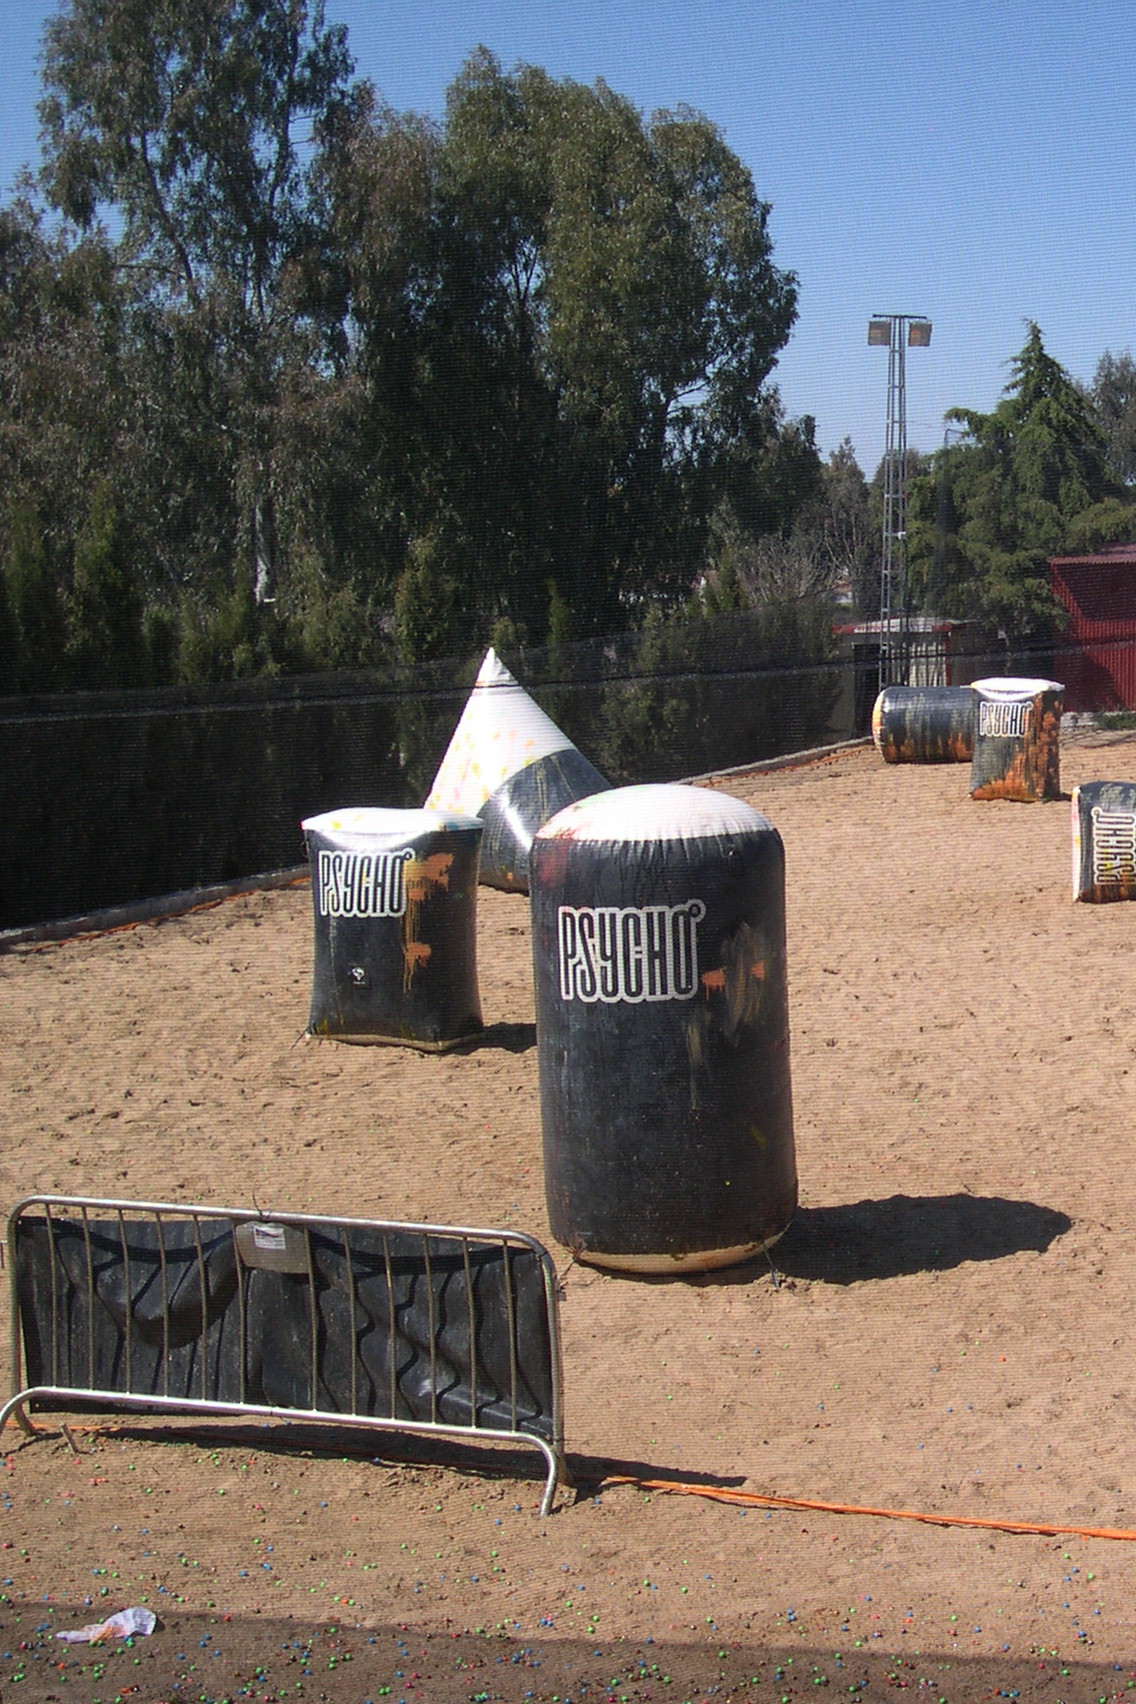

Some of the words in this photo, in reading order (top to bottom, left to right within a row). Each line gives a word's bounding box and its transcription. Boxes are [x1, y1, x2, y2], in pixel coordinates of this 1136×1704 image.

[980, 701, 1033, 737] PSYCHO
[318, 848, 415, 917] PSYCHO
[558, 899, 706, 1003] PSYCHO
